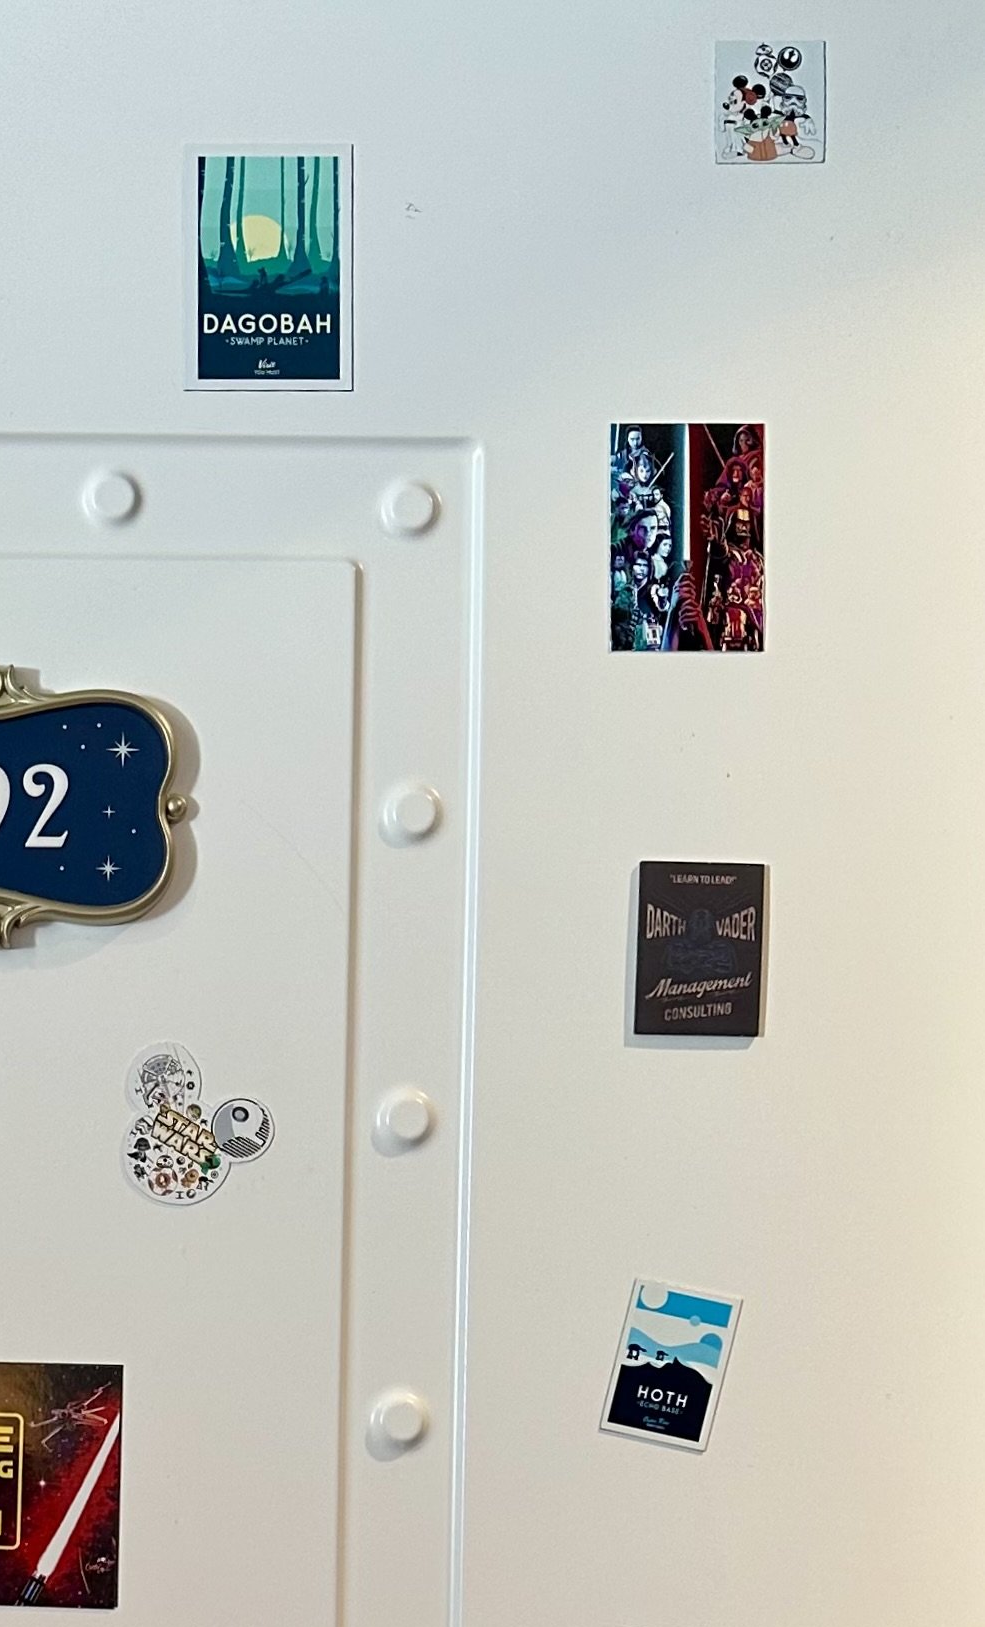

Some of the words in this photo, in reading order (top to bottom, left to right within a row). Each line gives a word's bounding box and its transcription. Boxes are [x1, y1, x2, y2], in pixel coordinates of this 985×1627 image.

[203, 313, 331, 334] DAGOBAH
[230, 336, 265, 346] SWAMP
[267, 336, 304, 346] PLANET
[699, 875, 711, 884] TO
[646, 903, 687, 939] DARTH
[715, 906, 757, 941] VADER
[645, 971, 753, 999] Management
[664, 1002, 732, 1021] CONSULTING
[156, 1109, 216, 1153] STAR
[637, 1384, 688, 1408] HOTH
